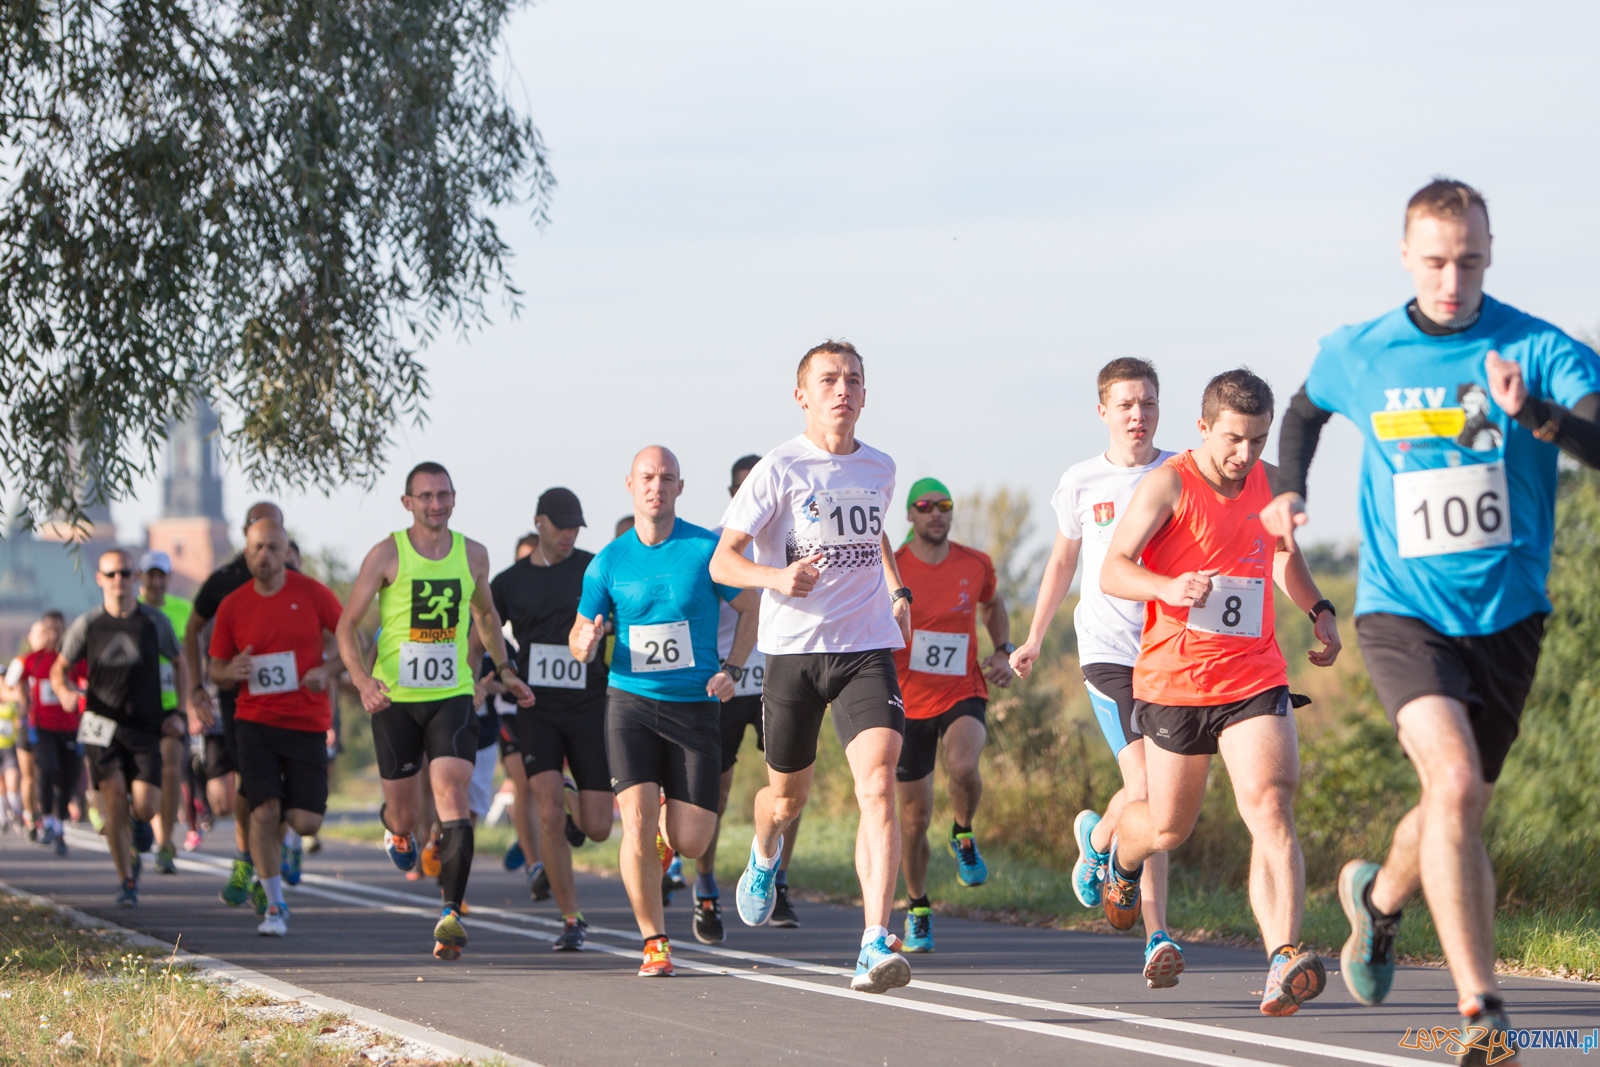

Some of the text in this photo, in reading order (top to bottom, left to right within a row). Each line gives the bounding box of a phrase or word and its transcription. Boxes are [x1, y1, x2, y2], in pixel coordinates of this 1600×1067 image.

[1383, 386, 1447, 410] XXV
[829, 505, 882, 537] 105
[1413, 490, 1502, 540] 106
[1222, 595, 1242, 627] 8
[644, 638, 680, 665] 26
[925, 645, 957, 669] 87
[257, 665, 286, 687] 63
[407, 656, 454, 681] 103
[537, 656, 582, 681] 100
[740, 665, 764, 689] 79
